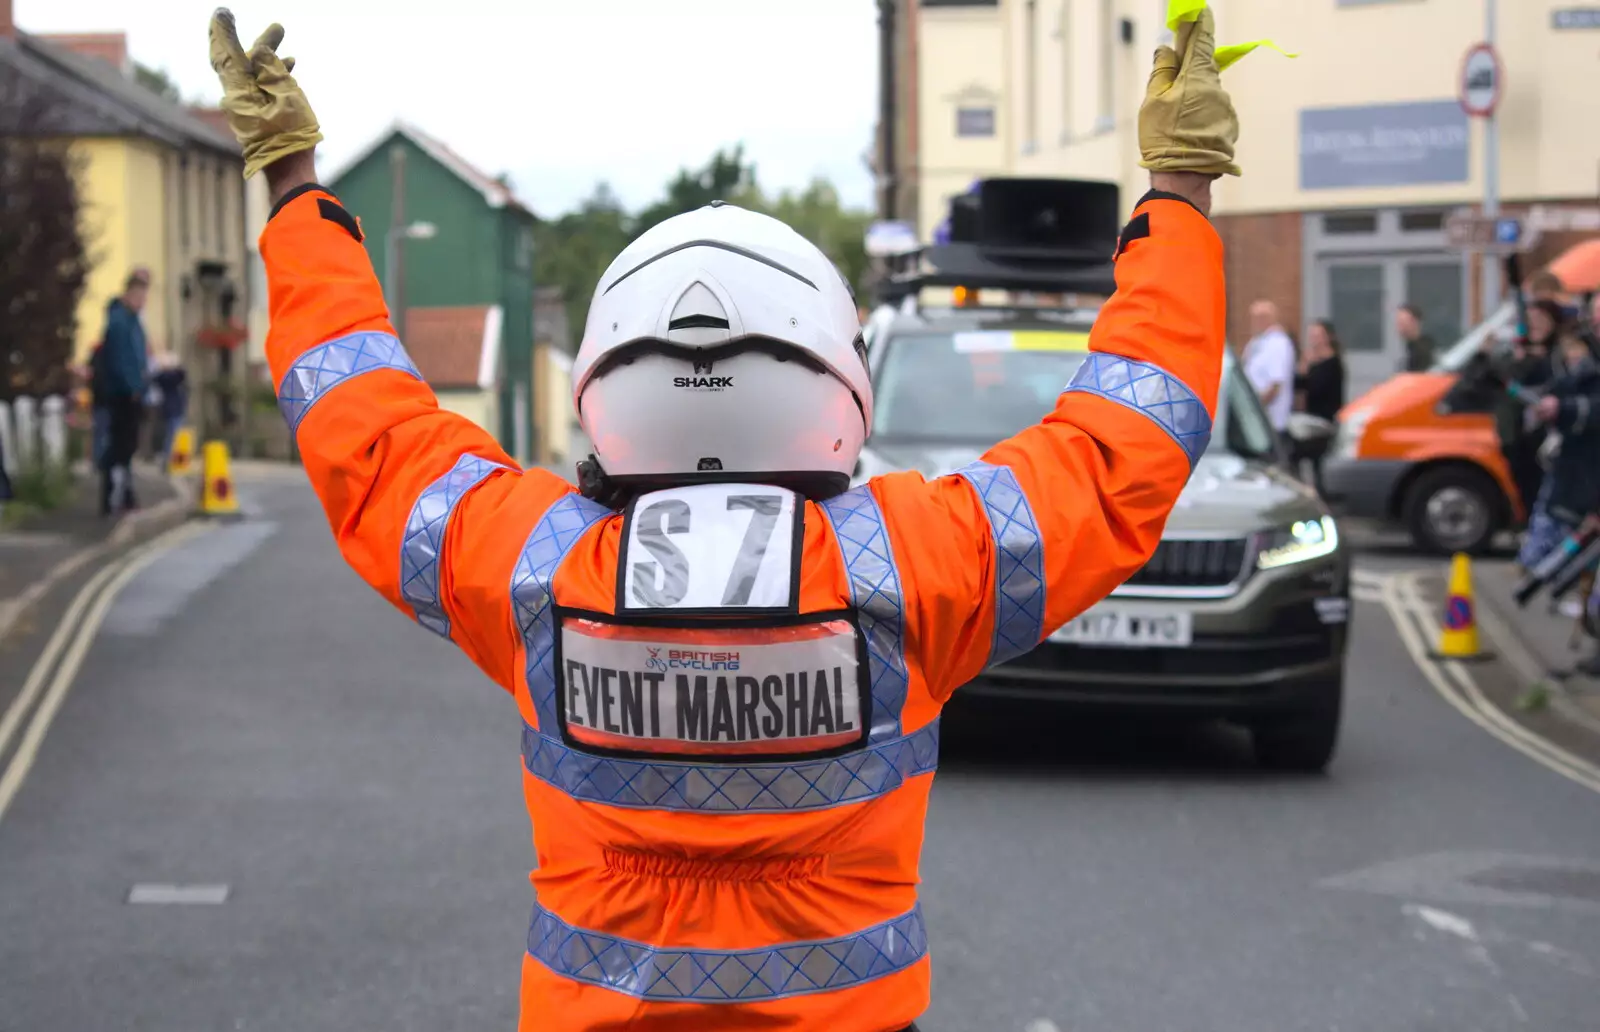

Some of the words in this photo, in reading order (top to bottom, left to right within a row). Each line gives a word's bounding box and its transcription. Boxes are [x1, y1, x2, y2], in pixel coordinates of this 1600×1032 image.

[673, 376, 734, 388] SHARK
[632, 499, 691, 607] S
[720, 495, 784, 606] 7
[668, 649, 740, 661] BRITISH
[668, 659, 740, 671] CYCLING
[567, 659, 664, 738] EVENT
[676, 667, 854, 742] MARSHAL
